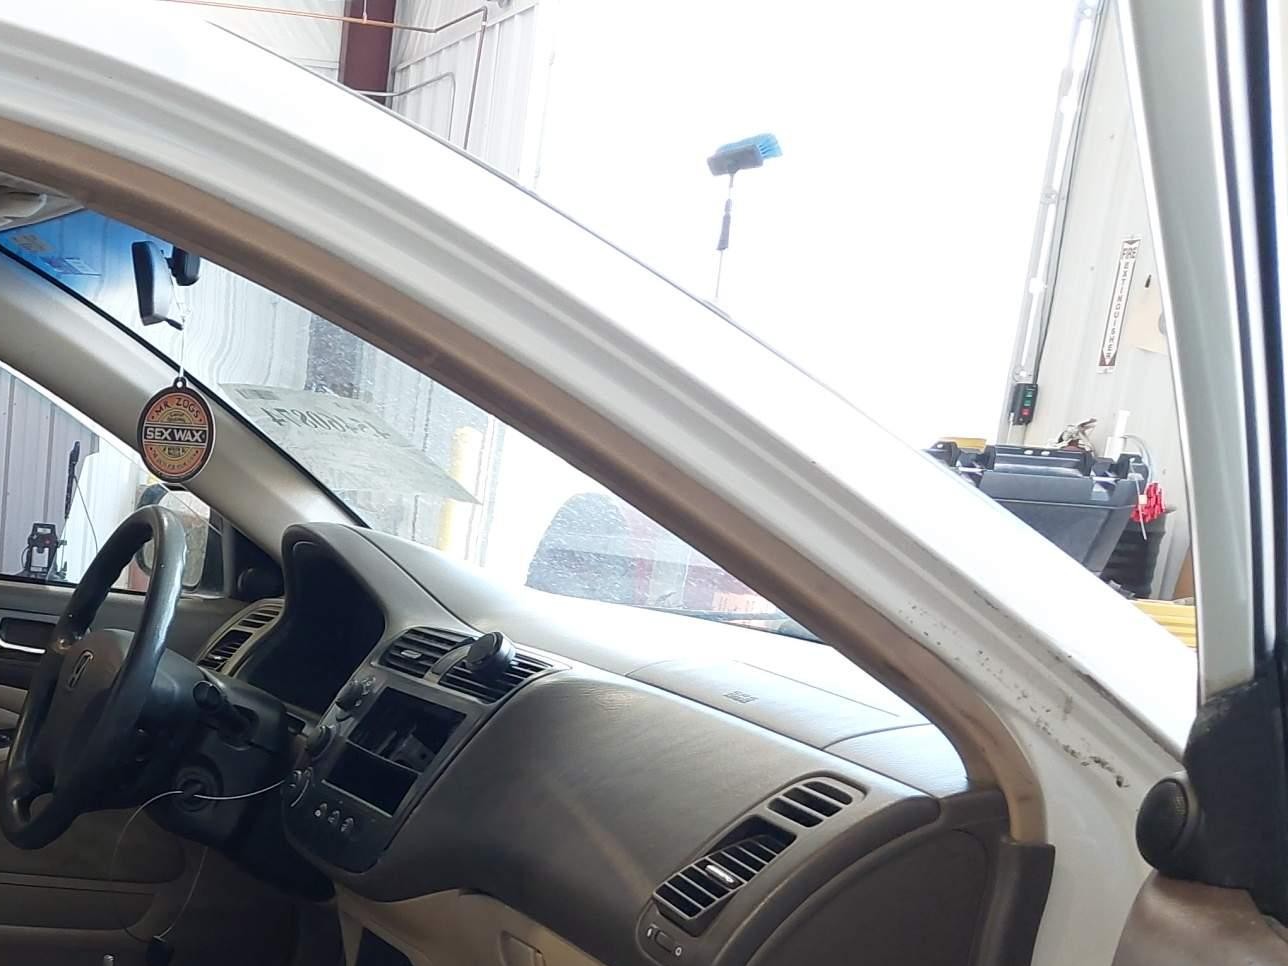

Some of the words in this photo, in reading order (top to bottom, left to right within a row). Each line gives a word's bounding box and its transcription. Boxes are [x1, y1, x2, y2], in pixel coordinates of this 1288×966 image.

[175, 397, 201, 418] ZOGS
[146, 427, 172, 441] SEX
[173, 428, 203, 443] WAX
